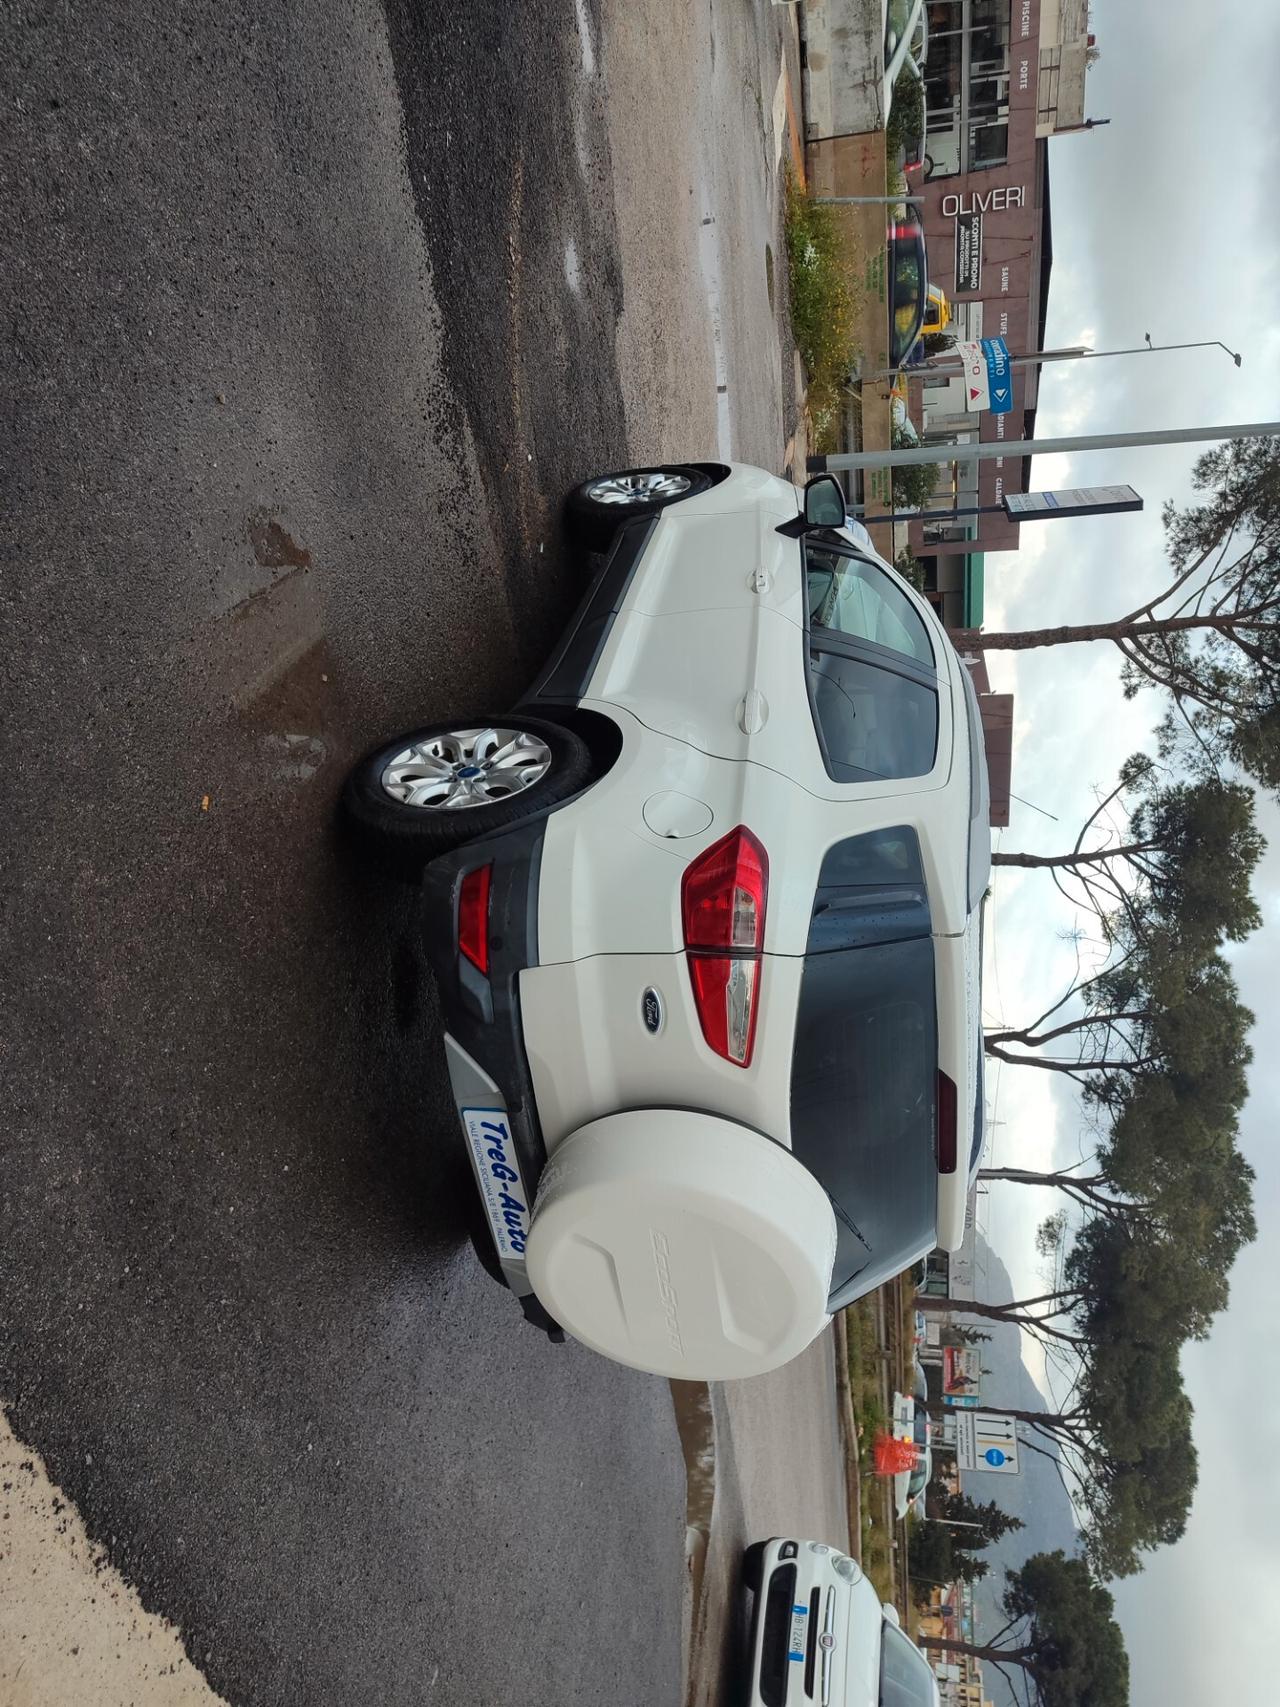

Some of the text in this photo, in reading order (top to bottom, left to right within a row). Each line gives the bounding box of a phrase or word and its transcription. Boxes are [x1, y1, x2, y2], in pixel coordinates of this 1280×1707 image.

[1020, 1, 1030, 90] PISCINE PORTE
[942, 186, 1025, 216] OLIVERI
[970, 258, 978, 288] PROMO
[646, 998, 658, 1026] Ford
[469, 1121, 478, 1136] VIALE
[473, 1139, 485, 1166] REGIONE
[480, 1168, 493, 1196] SICILIANA
[480, 1121, 528, 1253] TreG-Auto
[494, 1228, 508, 1252] PALERMO
